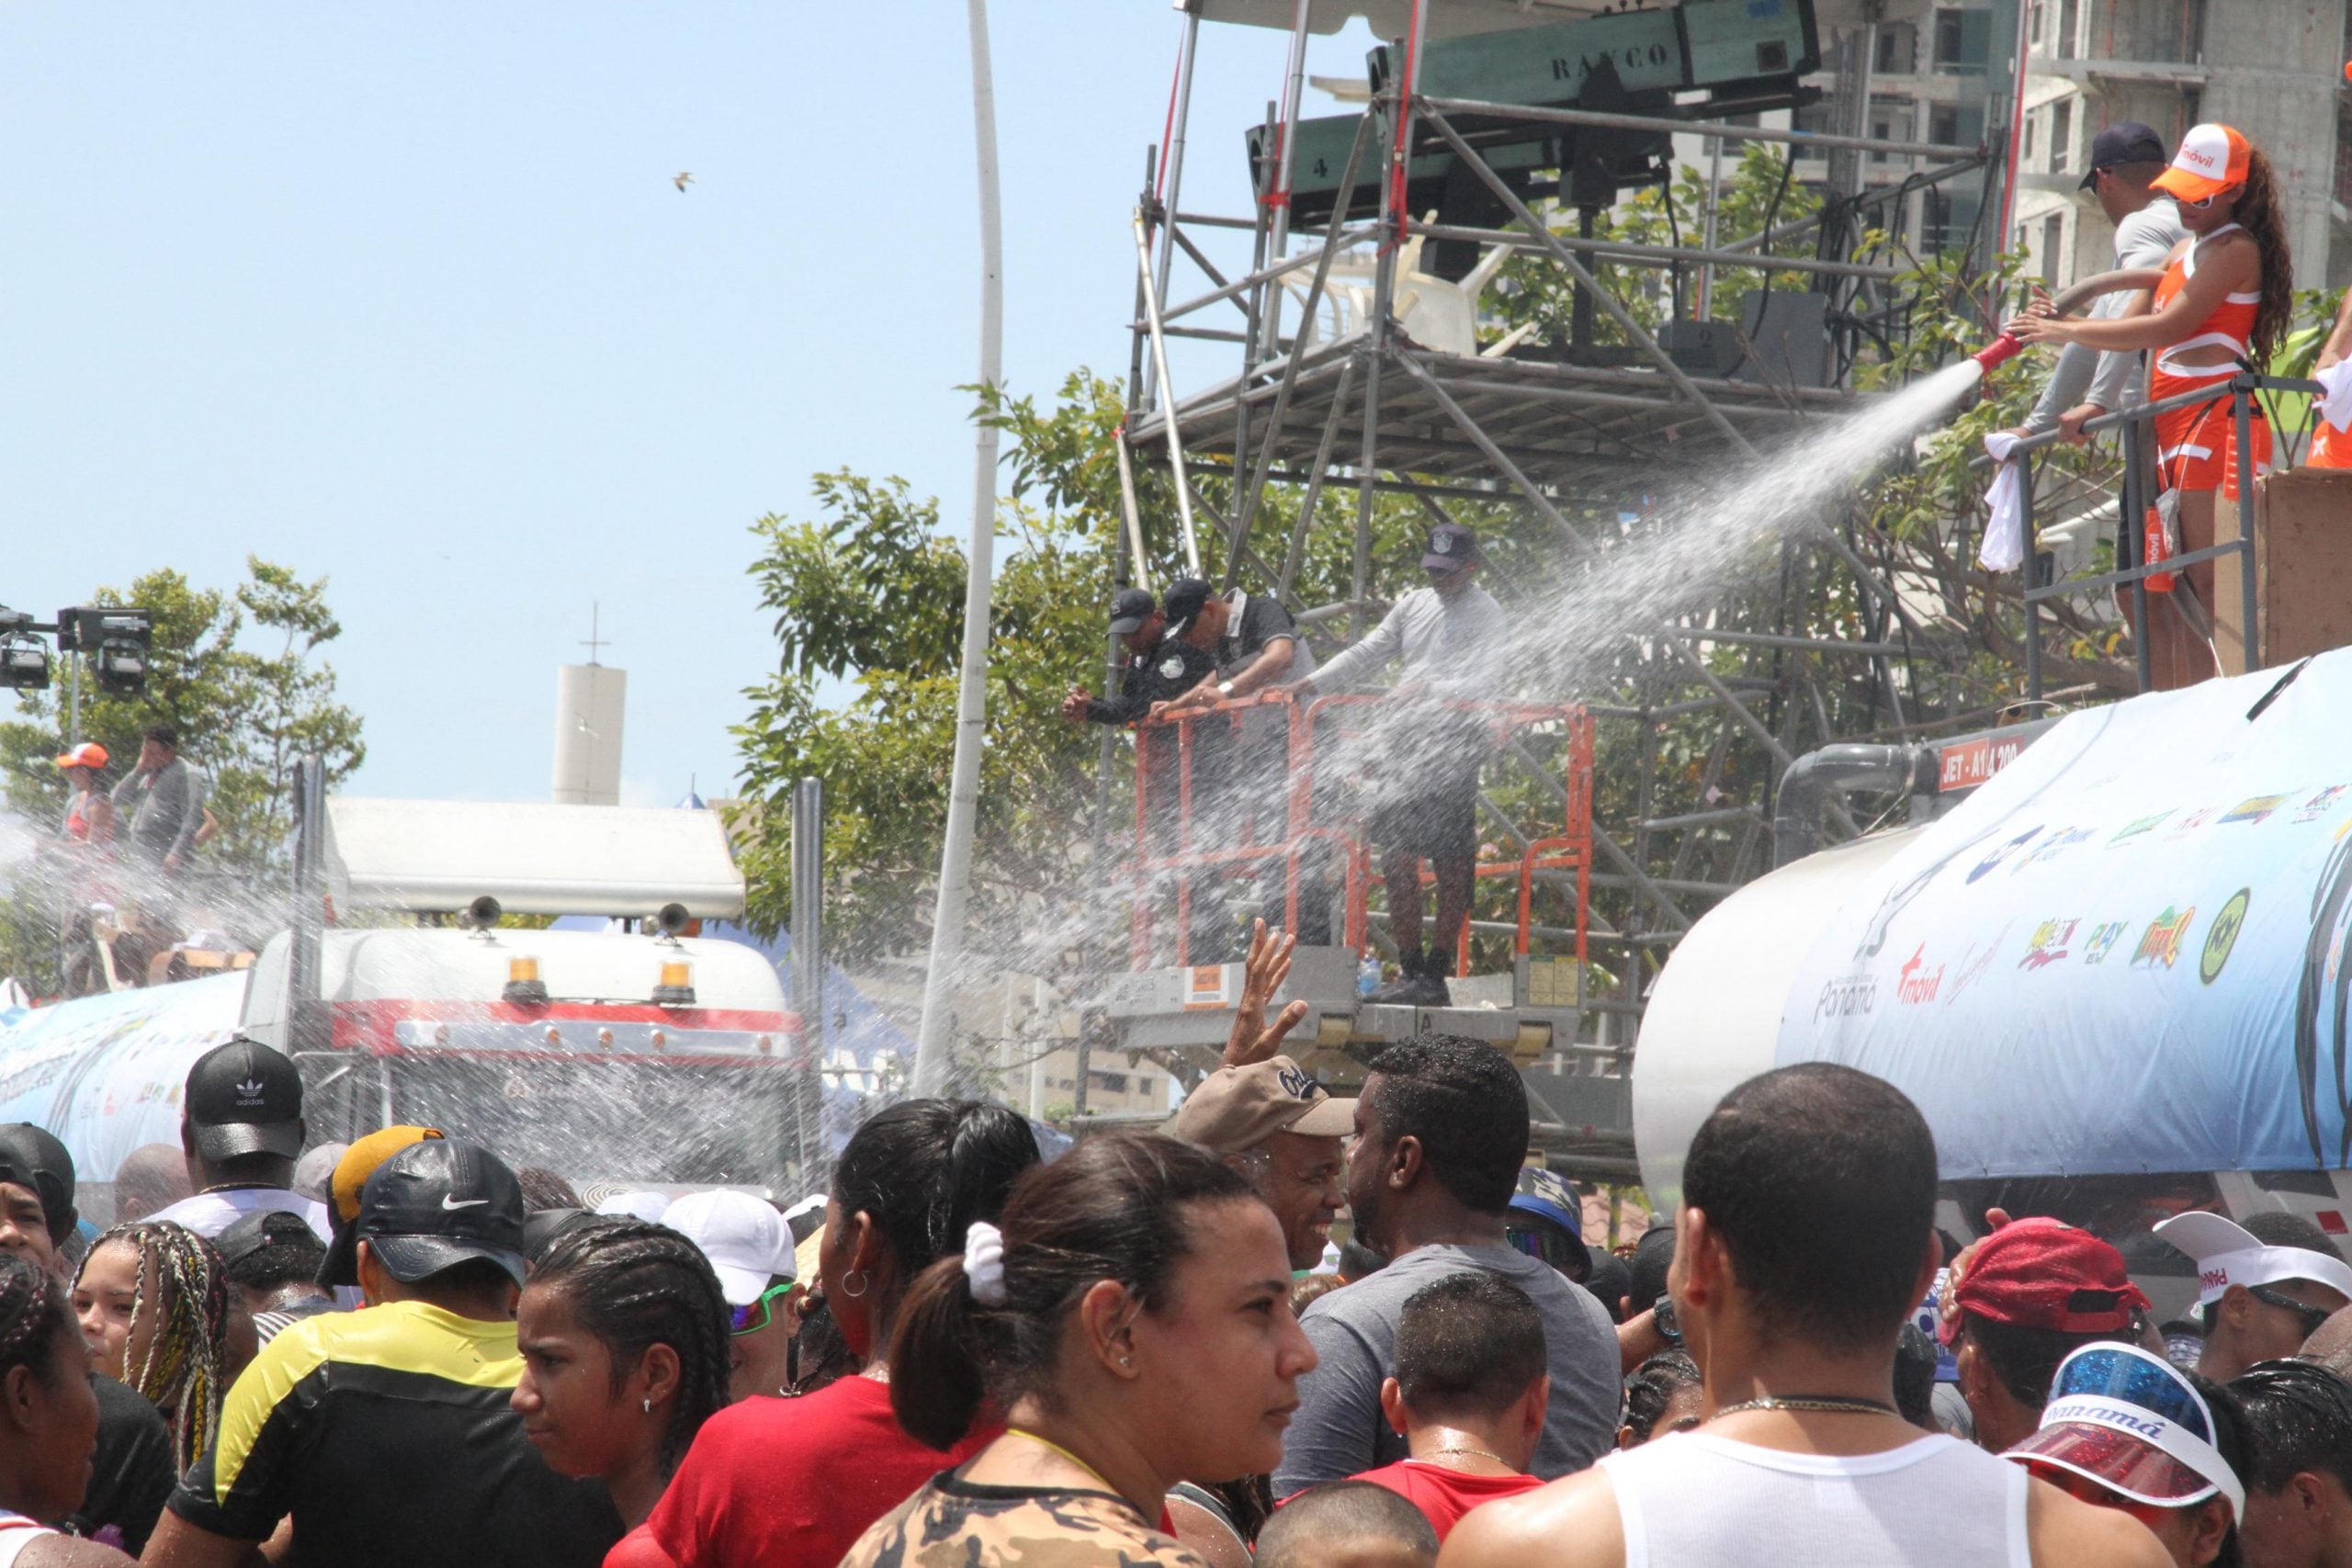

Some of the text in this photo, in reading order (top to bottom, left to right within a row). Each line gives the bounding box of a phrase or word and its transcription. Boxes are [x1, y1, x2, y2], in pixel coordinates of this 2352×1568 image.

[1314, 158, 1328, 178] 4
[1943, 754, 1964, 784] JET
[1813, 976, 1879, 1025] Panamá
[235, 1098, 265, 1106] adidas
